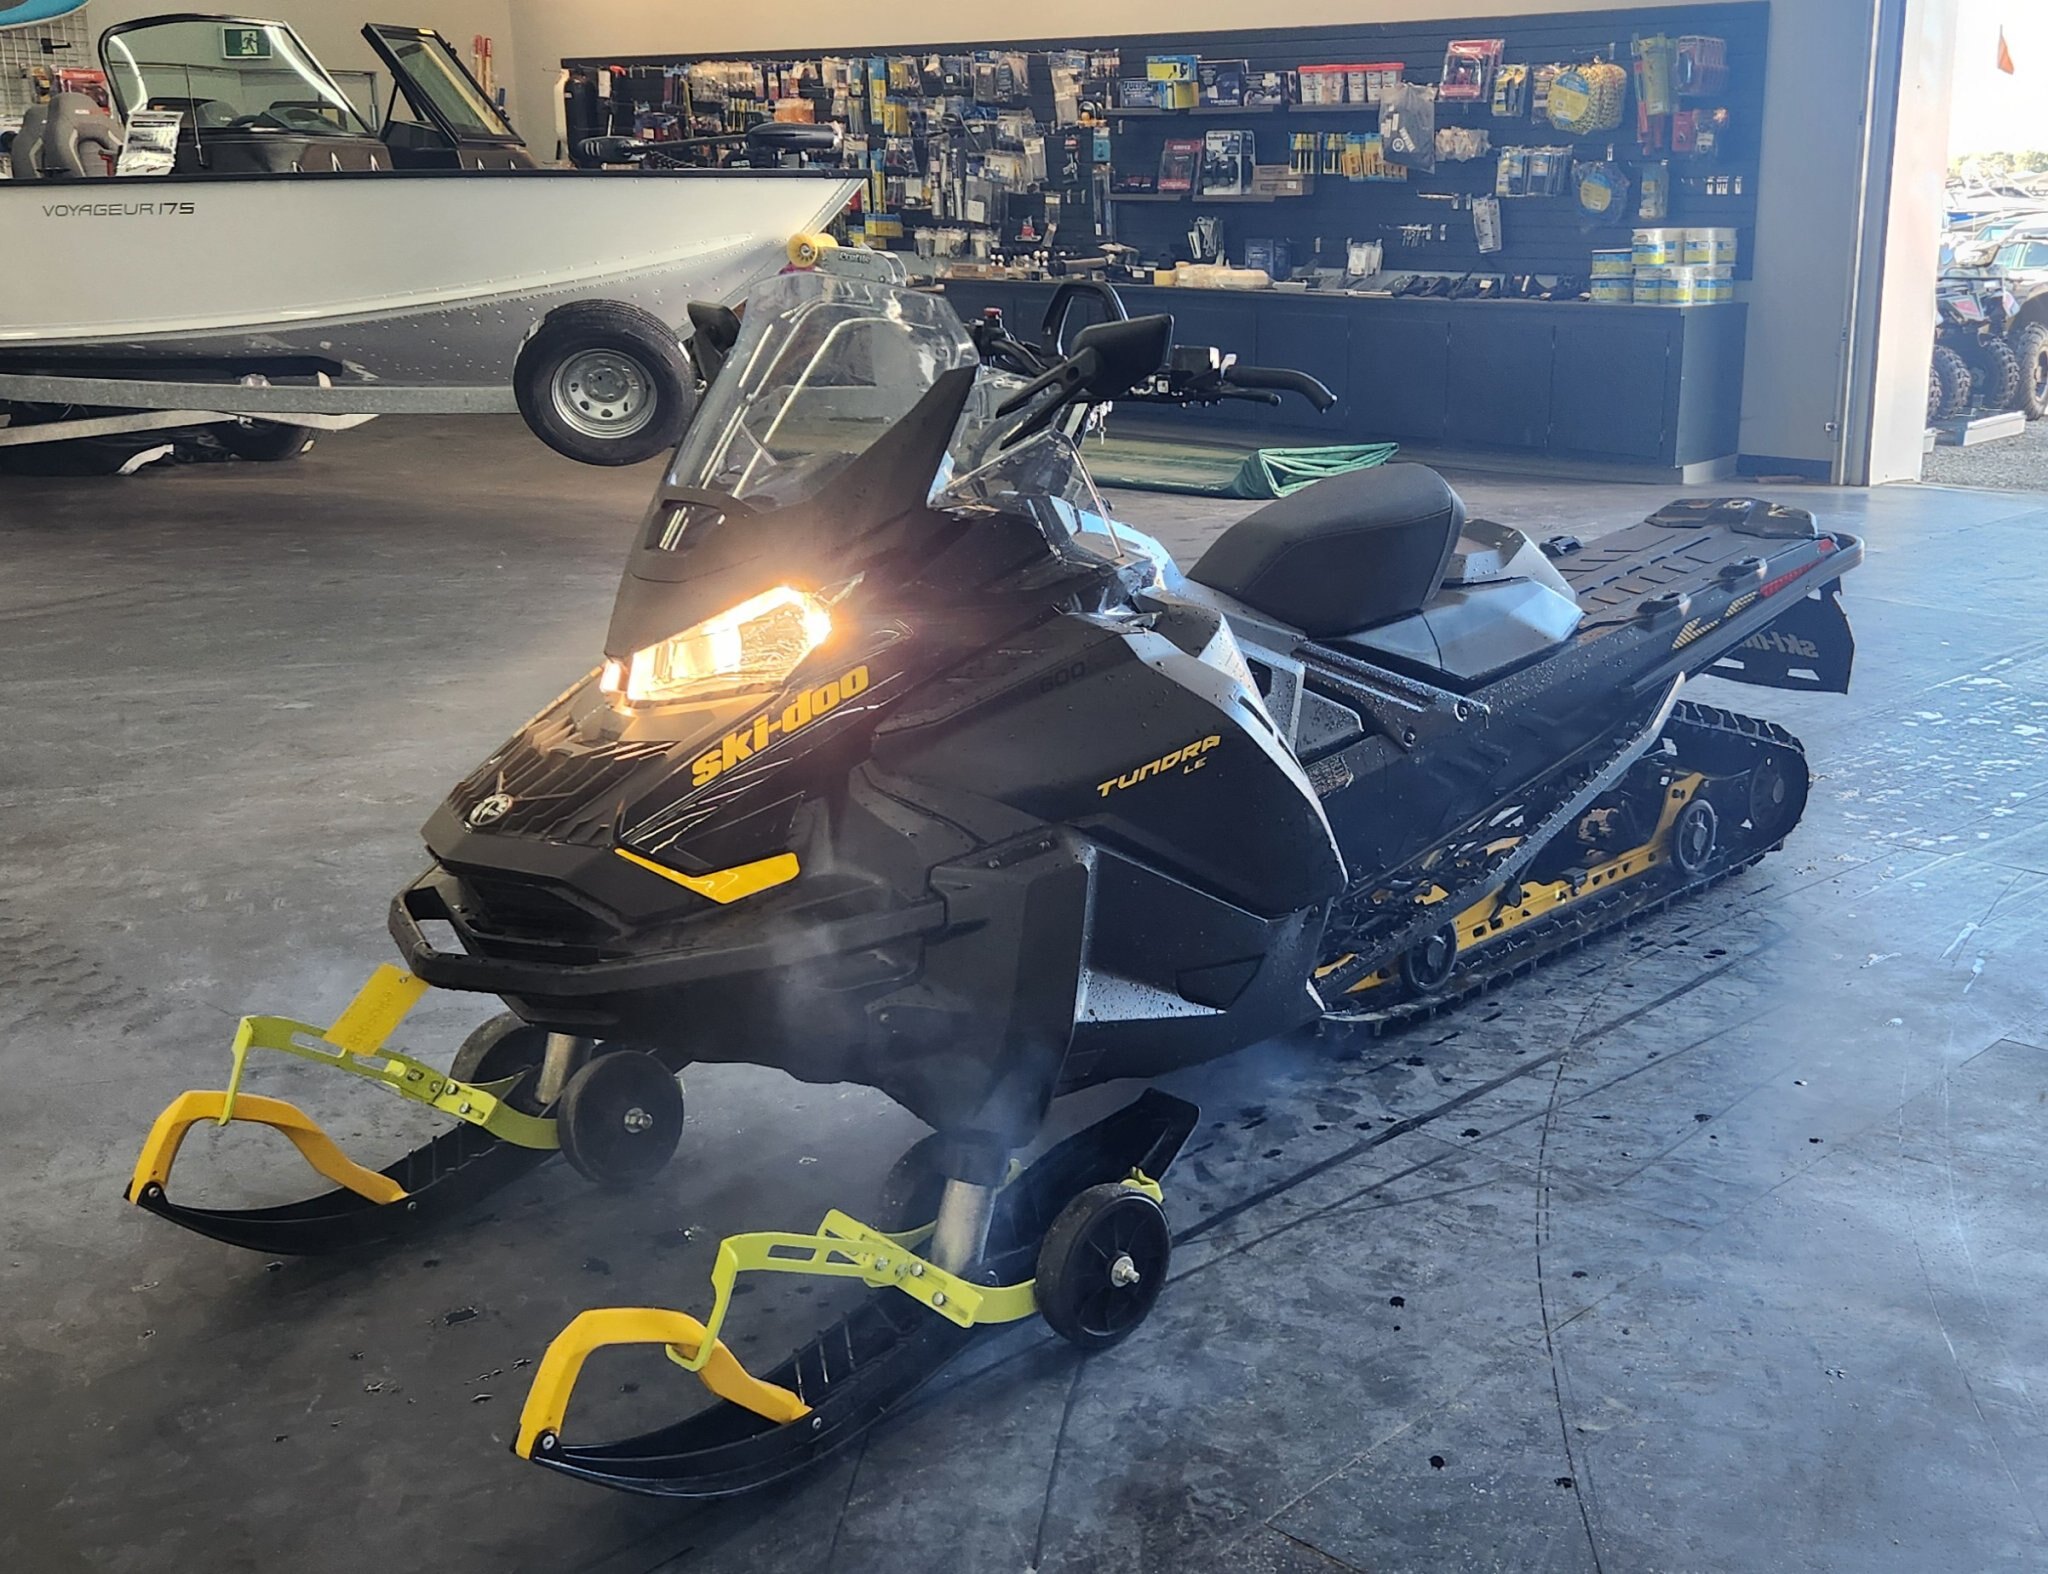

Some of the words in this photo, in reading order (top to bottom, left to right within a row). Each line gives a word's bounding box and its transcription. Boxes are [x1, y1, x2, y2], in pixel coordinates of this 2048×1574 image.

[42, 203, 154, 217] VOYAGEUR
[159, 202, 195, 215] 175
[1040, 661, 1086, 693] 600
[1097, 735, 1221, 797] TUNDRA
[1183, 756, 1207, 774] LE
